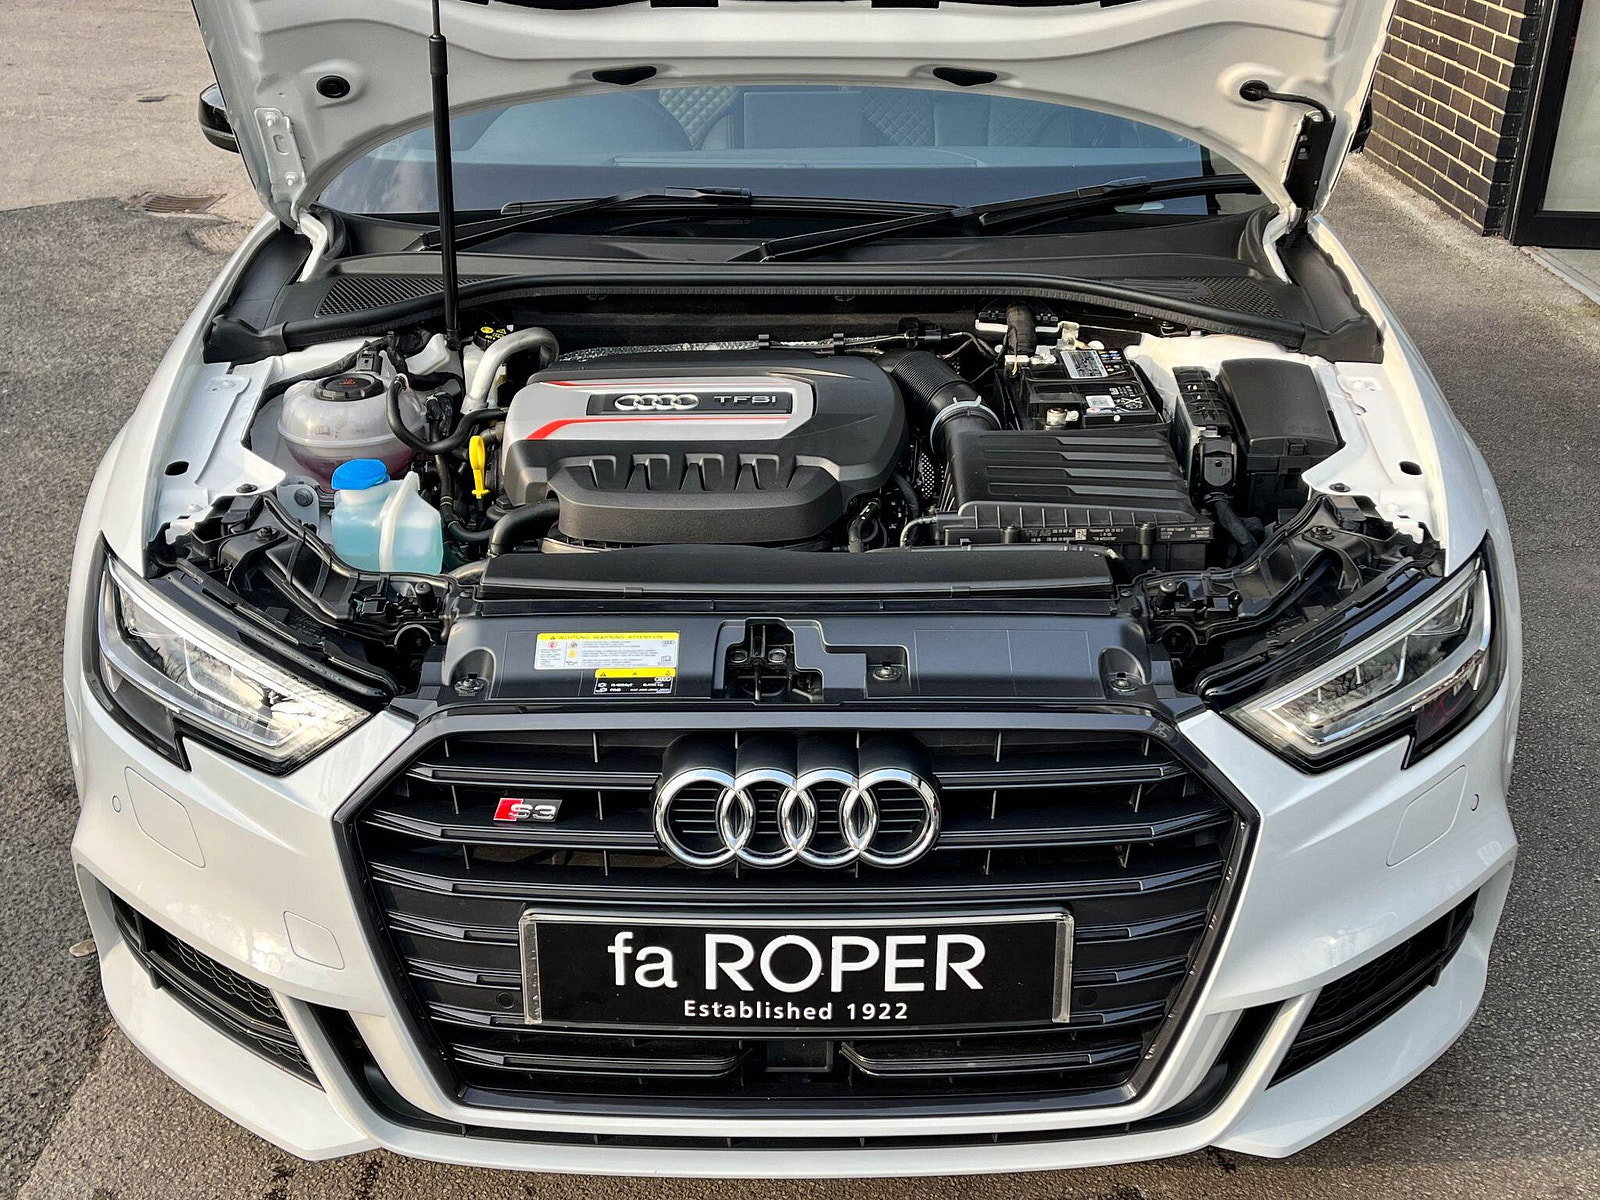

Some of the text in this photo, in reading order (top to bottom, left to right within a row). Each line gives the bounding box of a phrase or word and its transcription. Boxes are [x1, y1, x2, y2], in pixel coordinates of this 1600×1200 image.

[714, 395, 776, 404] TFSI
[509, 803, 557, 820] S3
[607, 931, 986, 993] fa ROPER
[684, 999, 908, 1020] Established 1922
